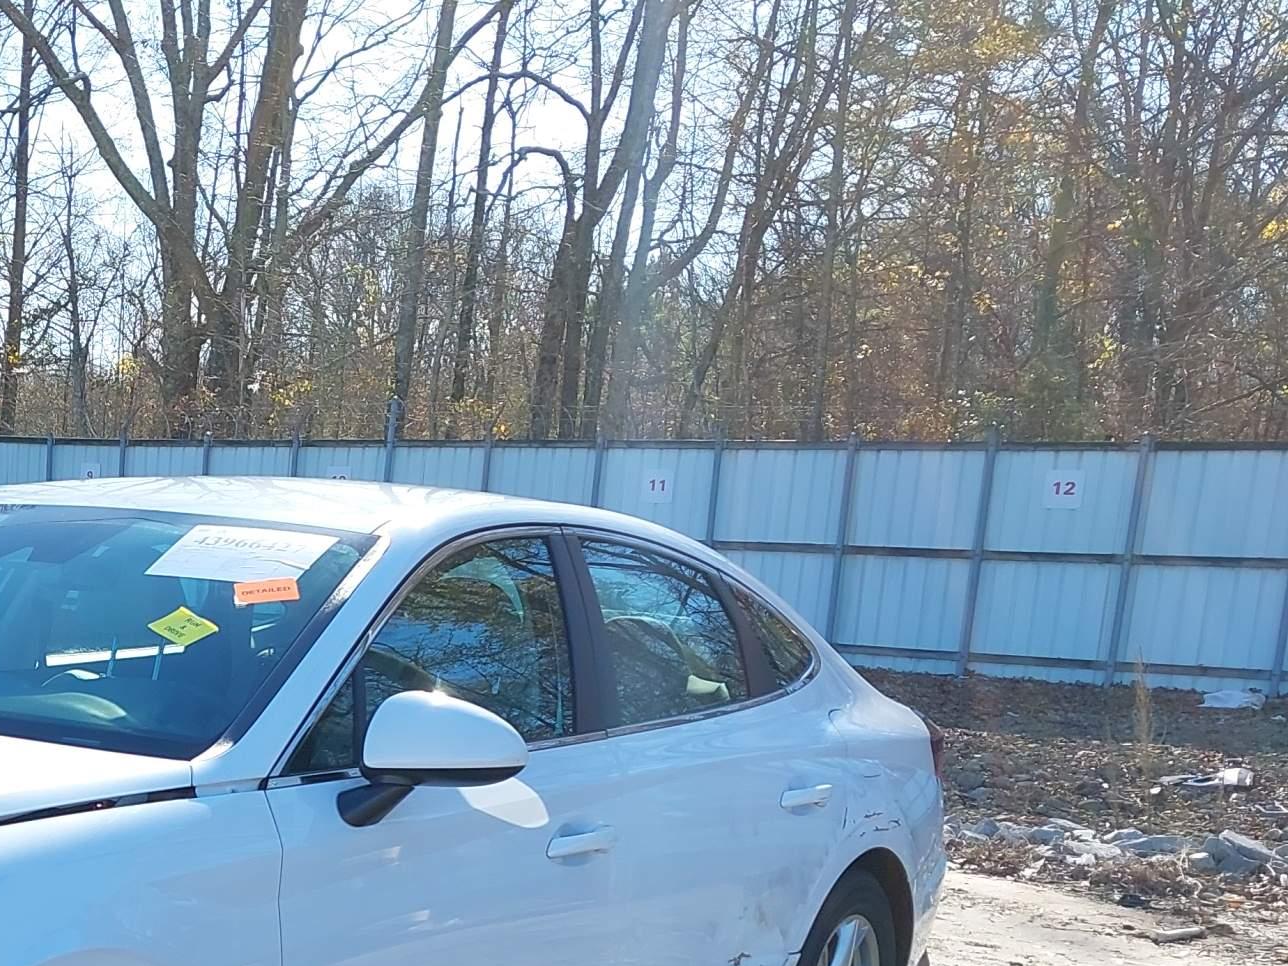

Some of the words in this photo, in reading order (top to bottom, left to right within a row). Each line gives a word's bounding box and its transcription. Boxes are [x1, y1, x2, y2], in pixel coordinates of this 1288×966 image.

[649, 479, 666, 492] 11
[1053, 481, 1076, 496] 12
[193, 535, 306, 553] 43966427
[241, 586, 291, 596] DETAILED
